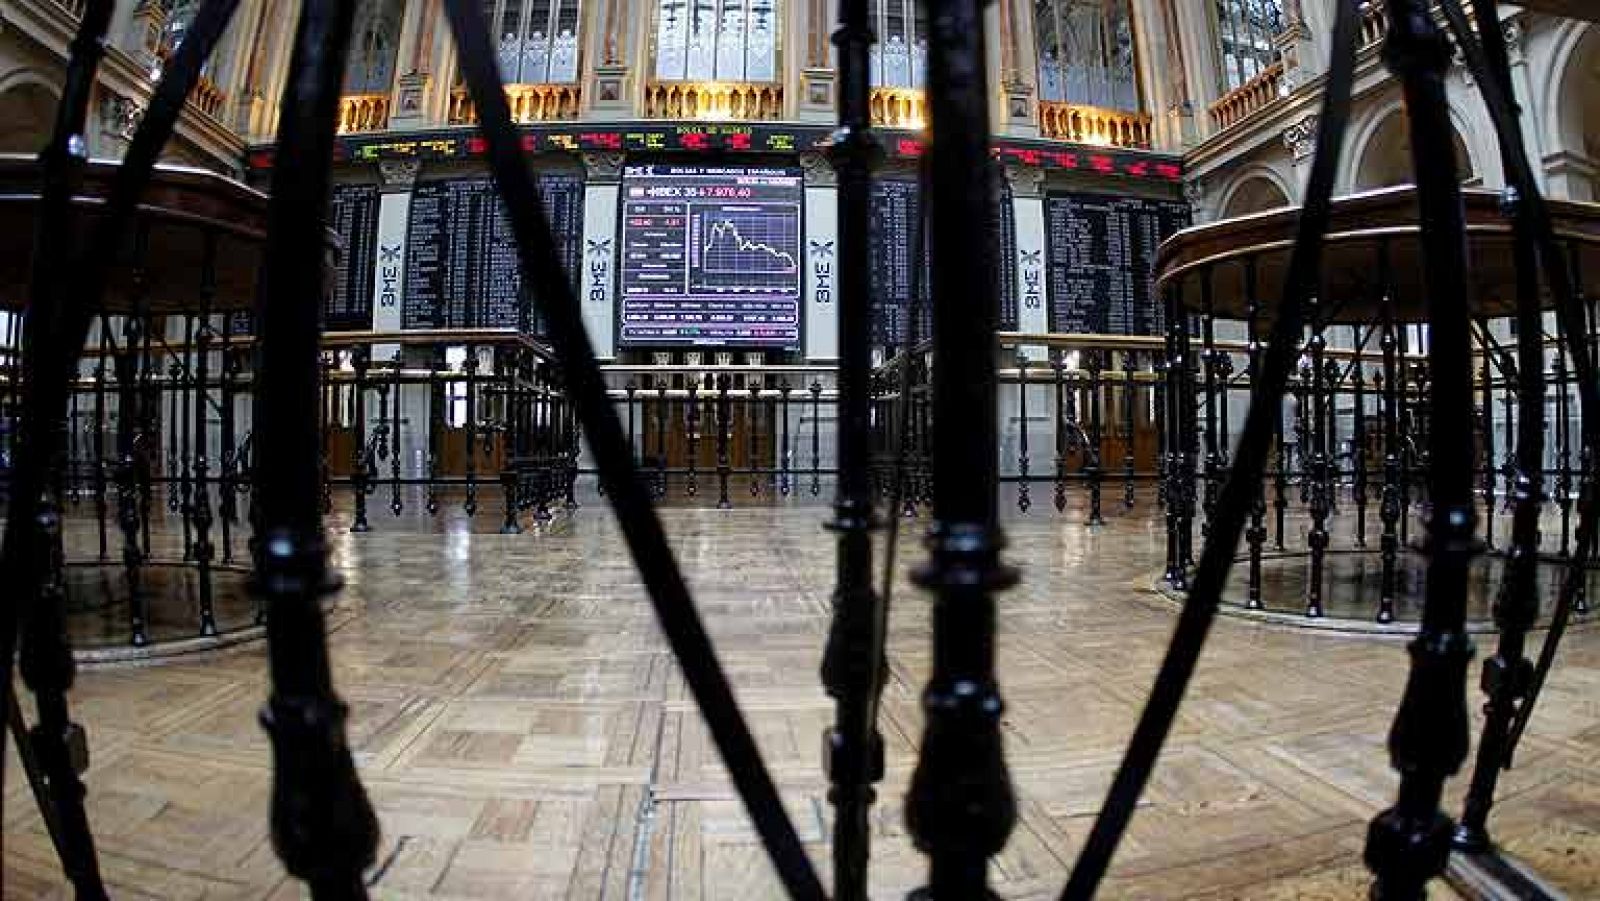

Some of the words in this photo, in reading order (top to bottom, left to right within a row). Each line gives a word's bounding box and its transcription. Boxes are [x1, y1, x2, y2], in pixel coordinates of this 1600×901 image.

[684, 187, 697, 197] 35
[815, 262, 830, 303] BME
[1025, 269, 1040, 309] BME
